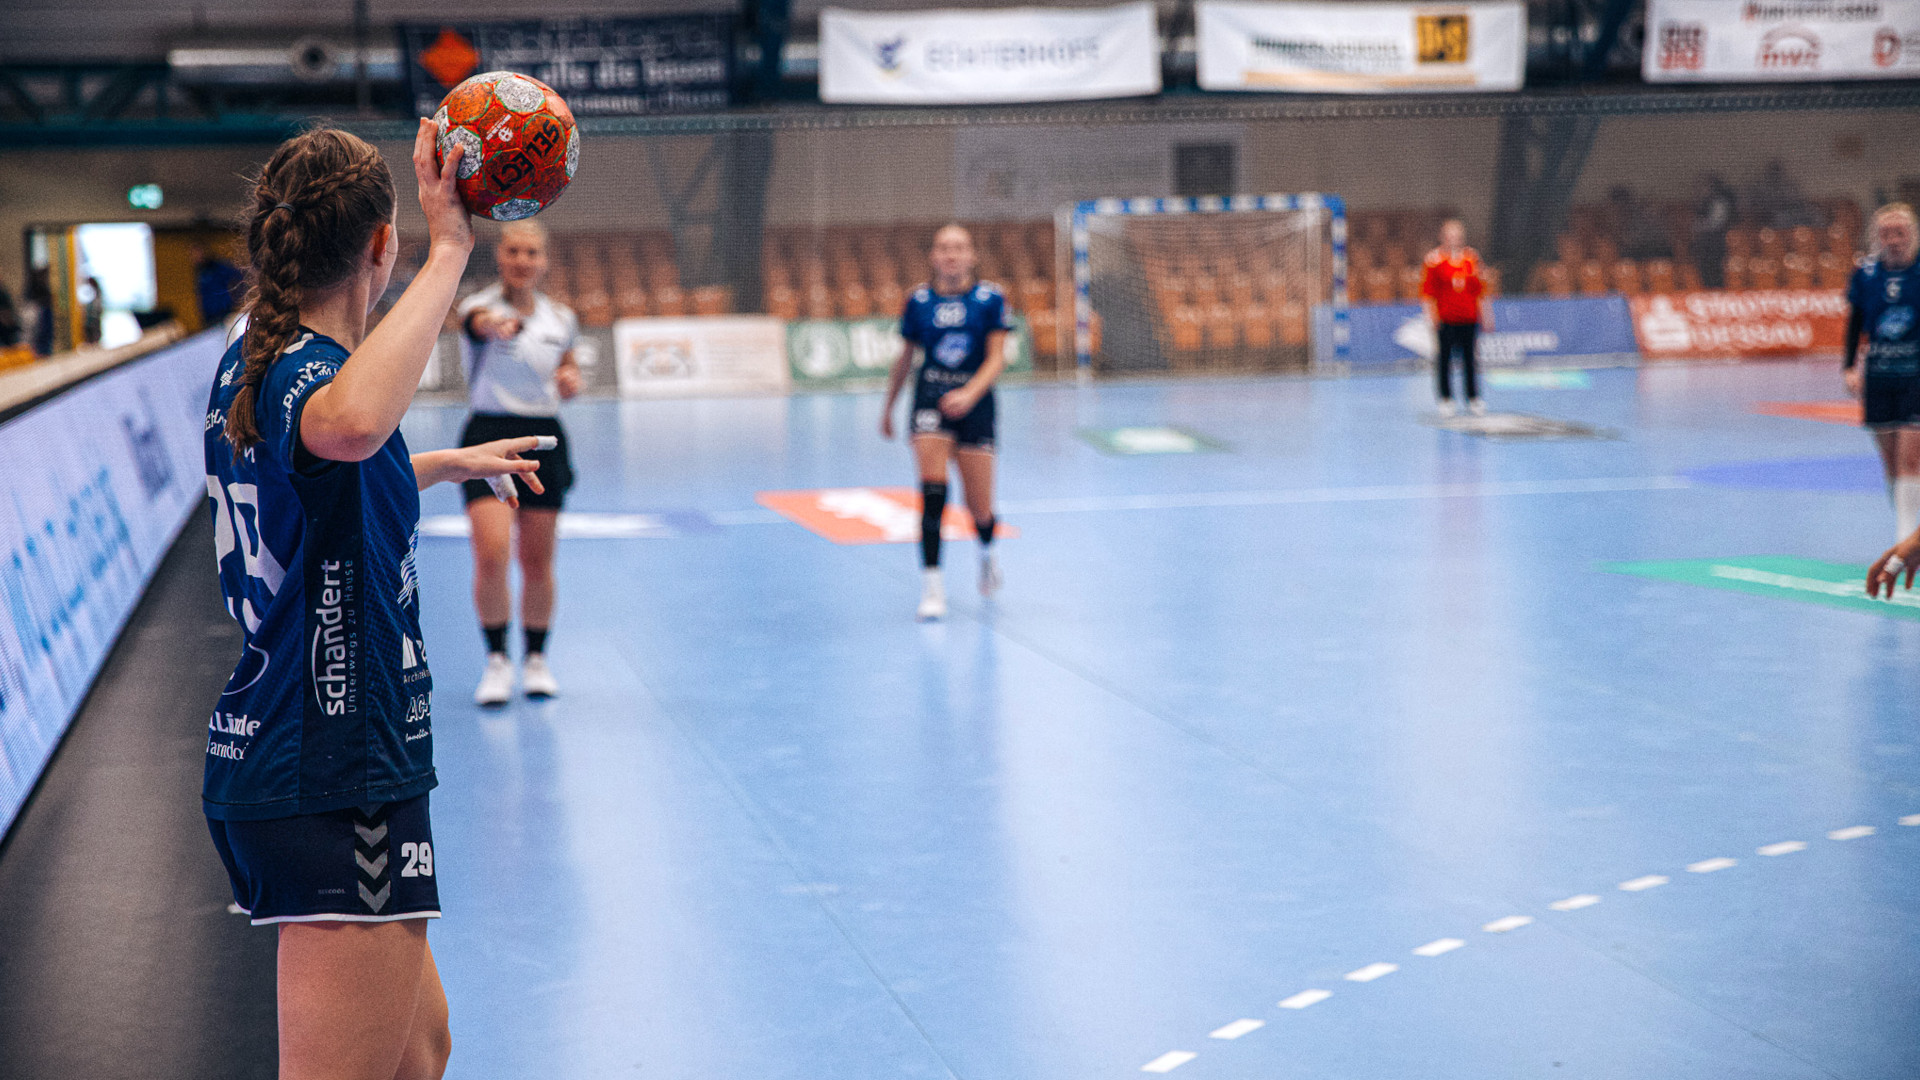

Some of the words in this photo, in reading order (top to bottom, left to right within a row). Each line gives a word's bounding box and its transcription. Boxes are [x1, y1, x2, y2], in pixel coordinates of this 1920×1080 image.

[490, 119, 560, 192] SELECT
[344, 559, 355, 602] Hause
[316, 559, 346, 716] schandert
[347, 609, 357, 625] zu
[347, 632, 358, 713] Unterwegs
[401, 842, 433, 877] 29
